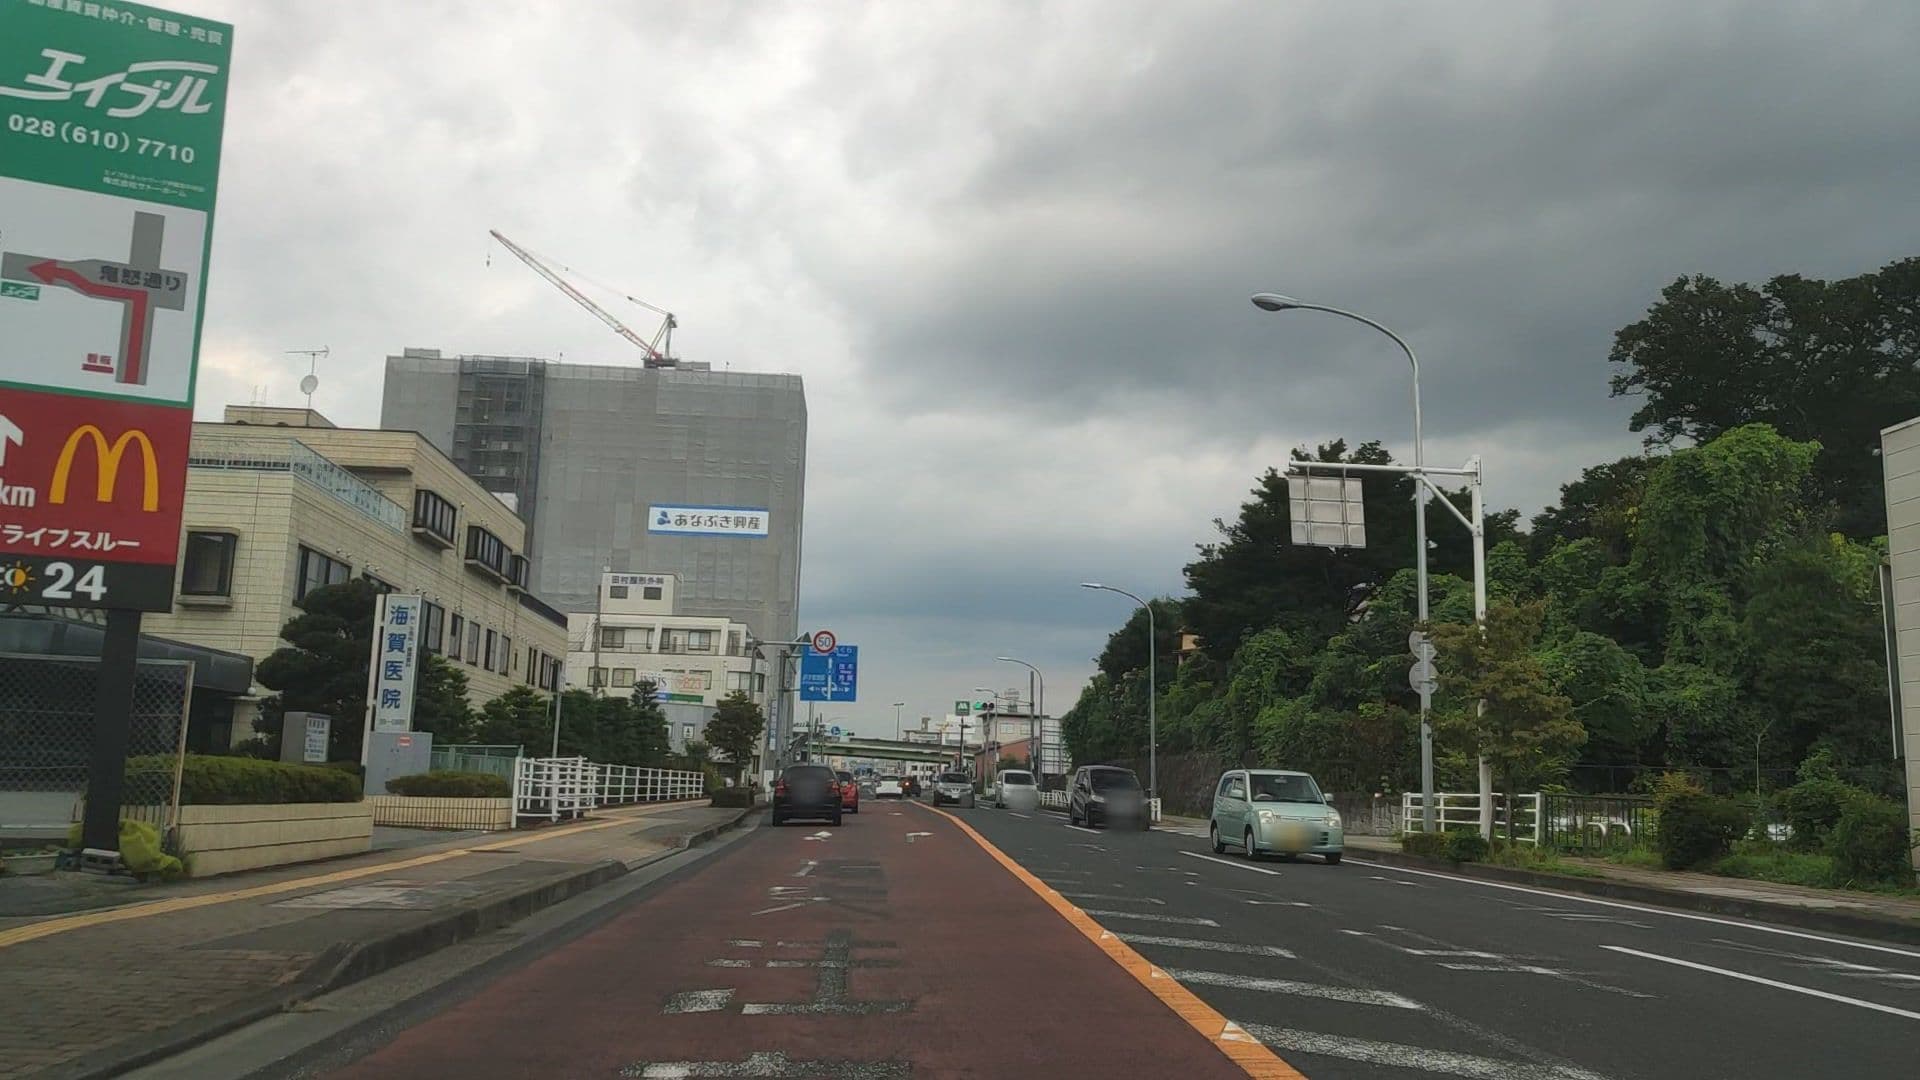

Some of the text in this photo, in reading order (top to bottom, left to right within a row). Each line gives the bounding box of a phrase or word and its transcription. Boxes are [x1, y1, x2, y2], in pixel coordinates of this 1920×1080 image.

[0, 48, 219, 118] エイブル
[100, 265, 181, 291] 鬼怒通り
[674, 514, 761, 530] あなぶき興産
[42, 561, 107, 601] 24
[381, 605, 409, 710] 海賀医院
[818, 636, 831, 648] 50
